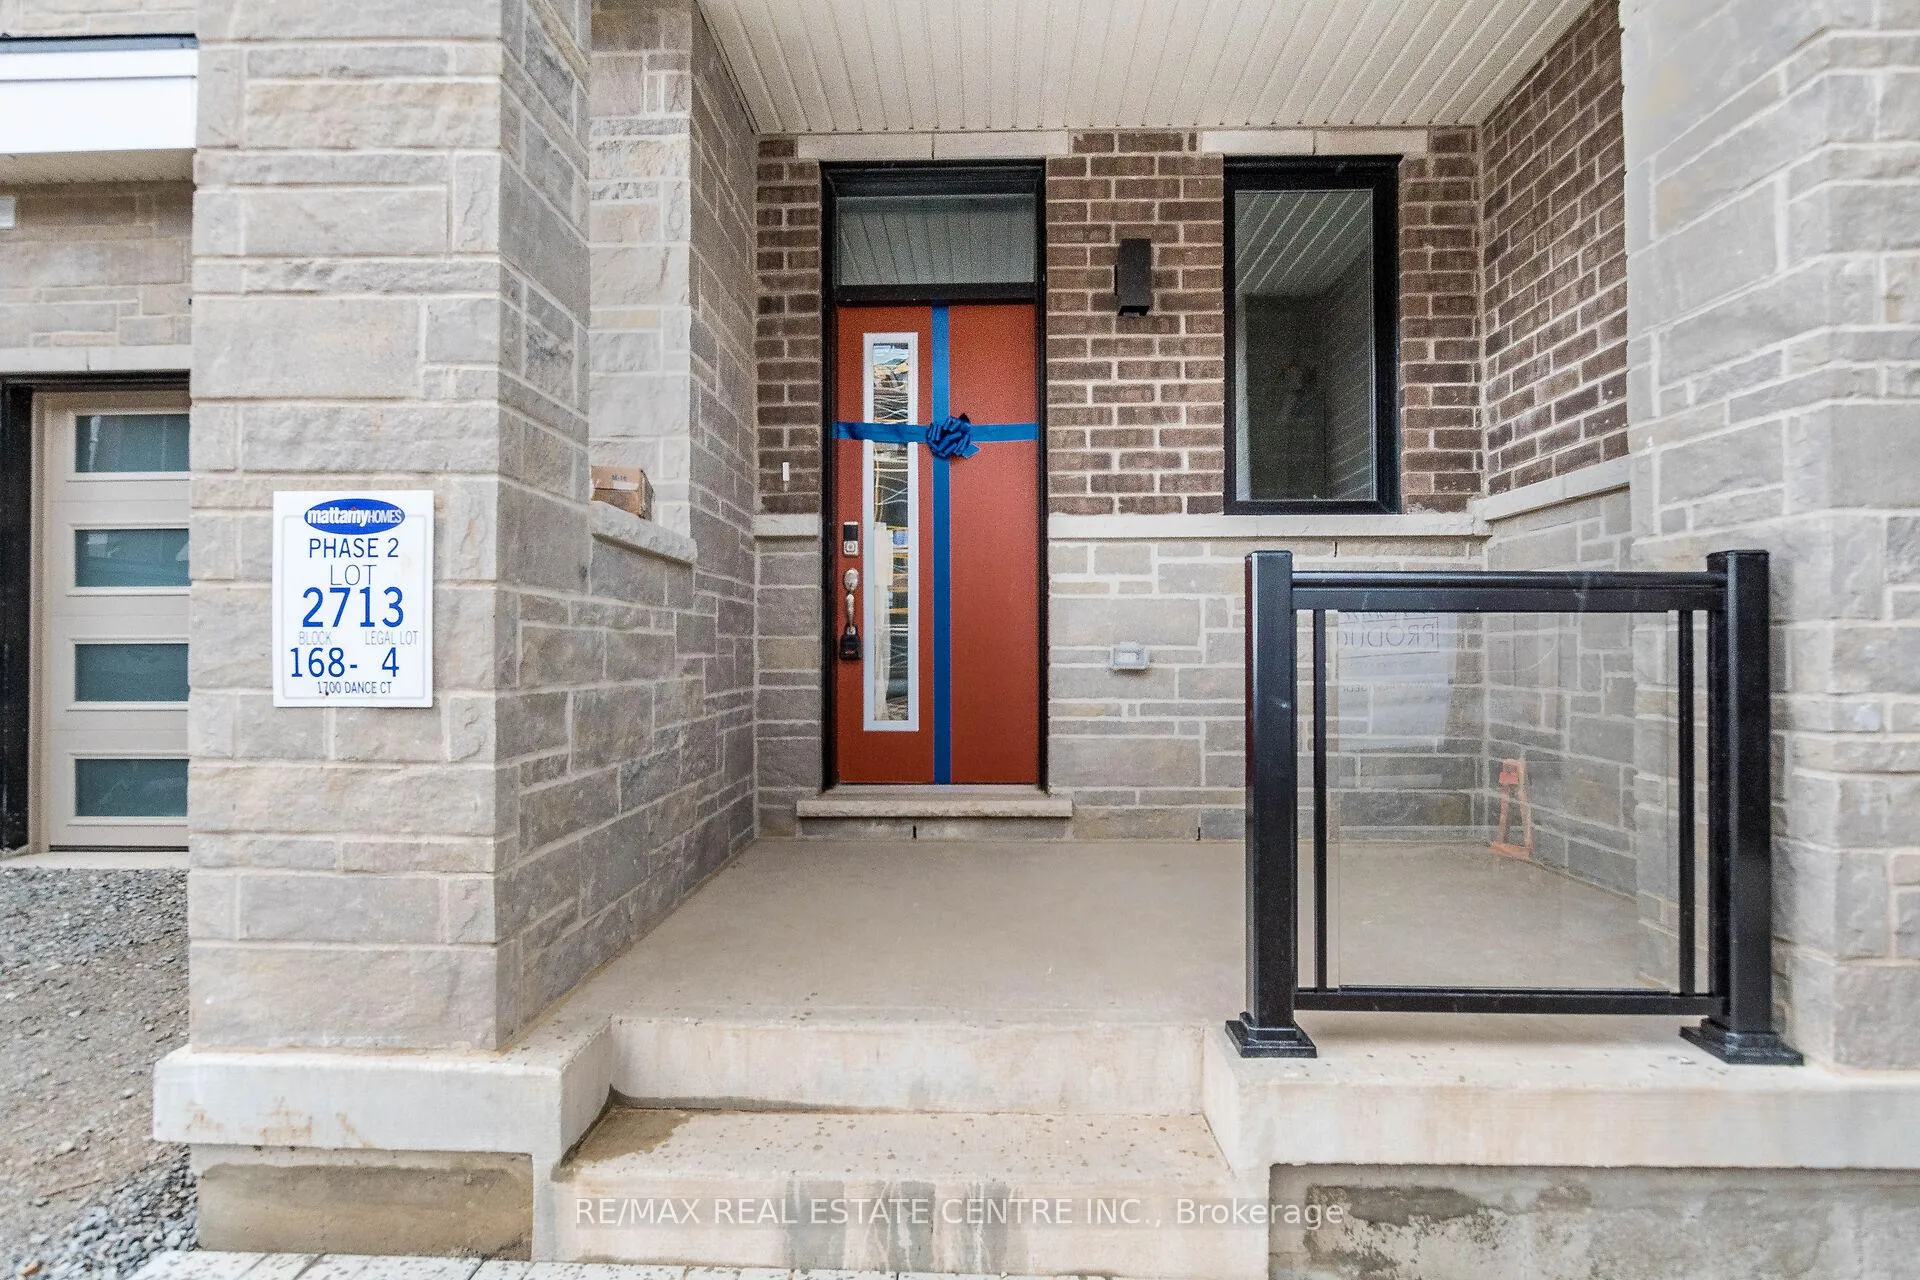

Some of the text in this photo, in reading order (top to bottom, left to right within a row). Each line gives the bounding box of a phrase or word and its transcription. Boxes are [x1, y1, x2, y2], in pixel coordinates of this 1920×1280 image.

[309, 538, 399, 558] PHASE 2
[330, 564, 377, 585] LOT
[302, 587, 404, 628] 2713
[298, 631, 332, 645] BLOCK
[364, 631, 419, 645] LEGAL LOT
[290, 647, 399, 678] 168- 4
[318, 682, 392, 695] 1700 DANCE CT
